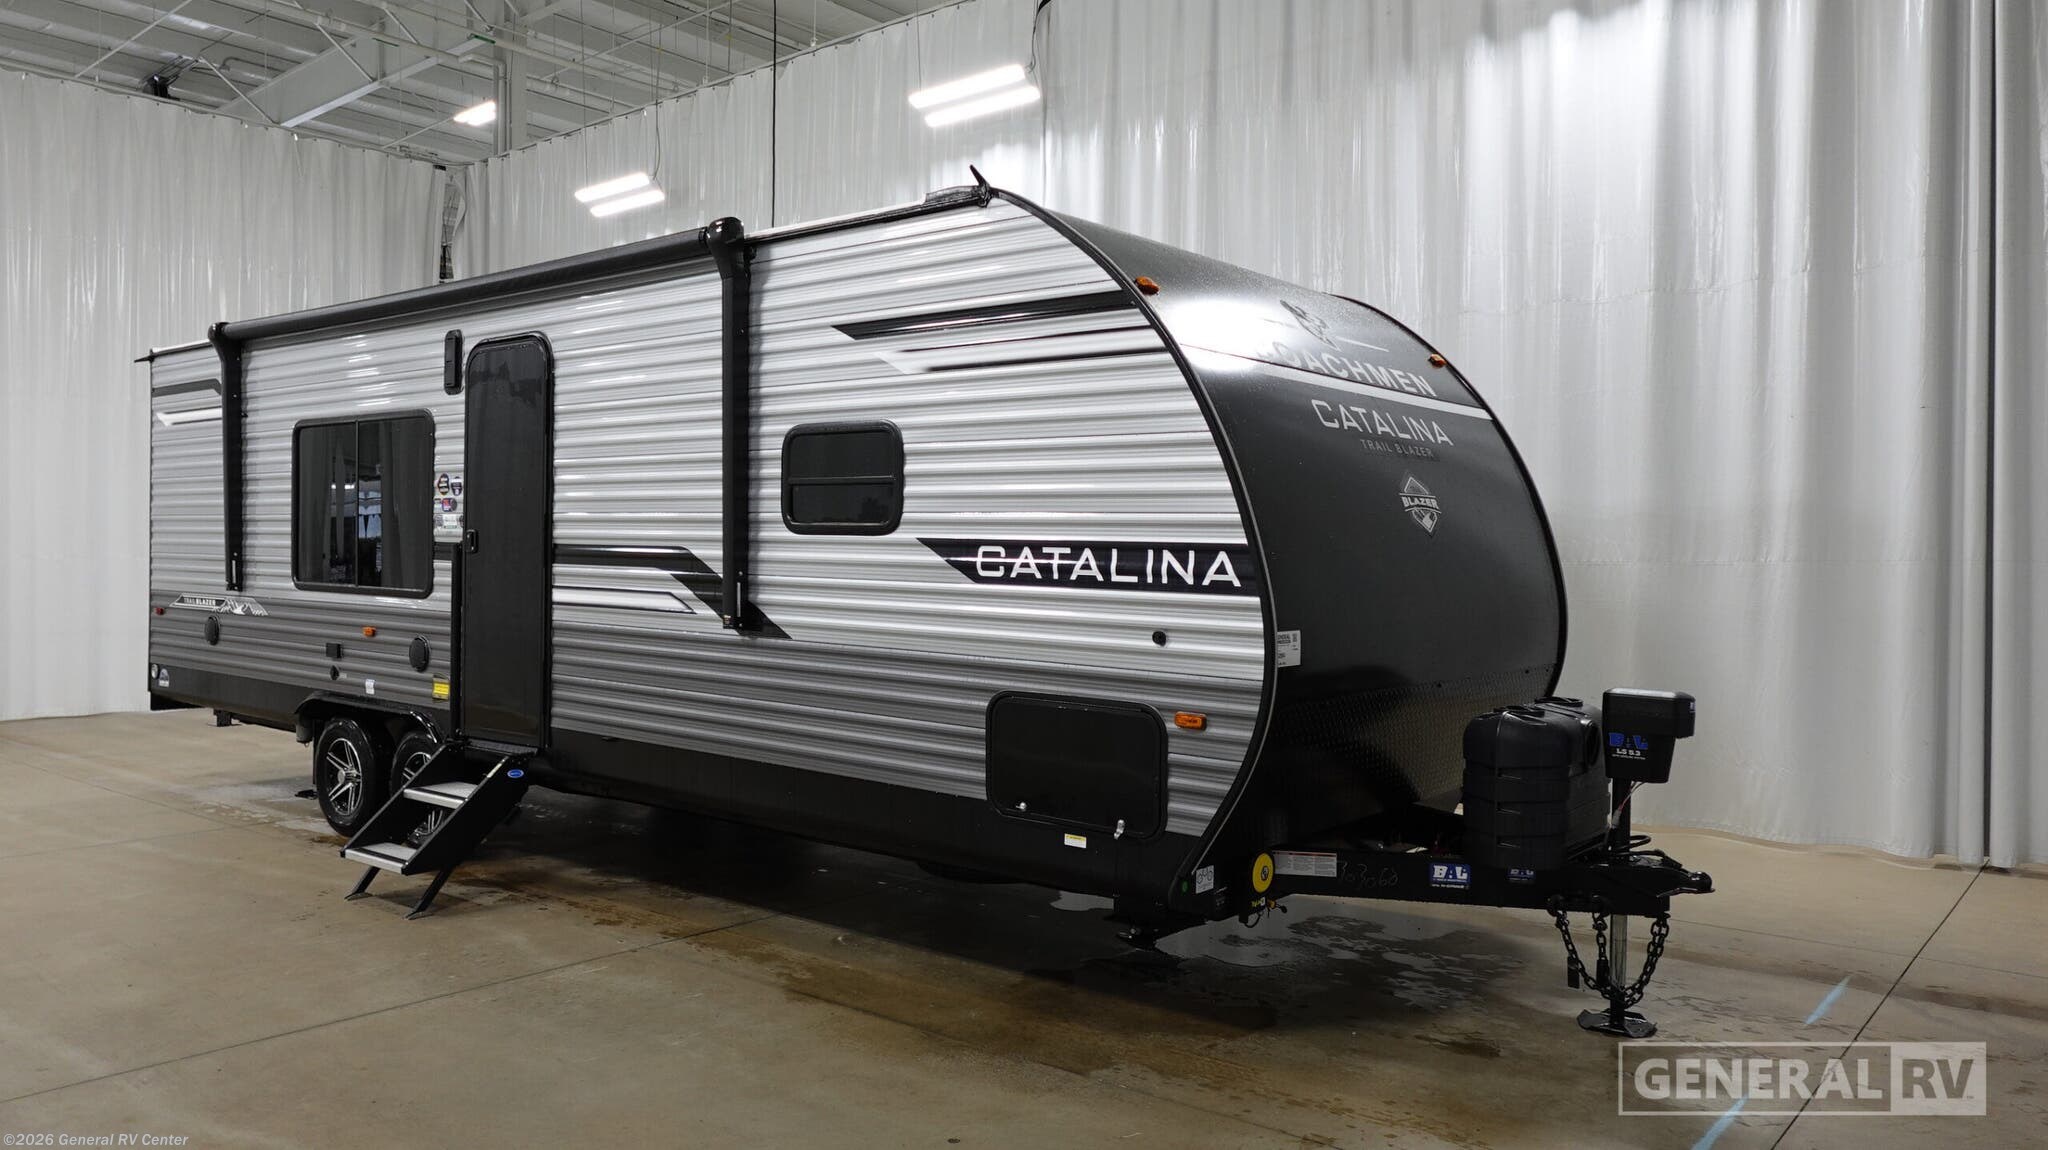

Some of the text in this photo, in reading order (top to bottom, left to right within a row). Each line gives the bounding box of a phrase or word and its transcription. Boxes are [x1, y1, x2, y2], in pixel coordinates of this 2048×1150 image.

[1311, 399, 1453, 446] CATALINA
[1360, 439, 1435, 458] TRAIL BLAZER
[1401, 496, 1440, 510] BLAZER
[975, 545, 1242, 588] CATALINA
